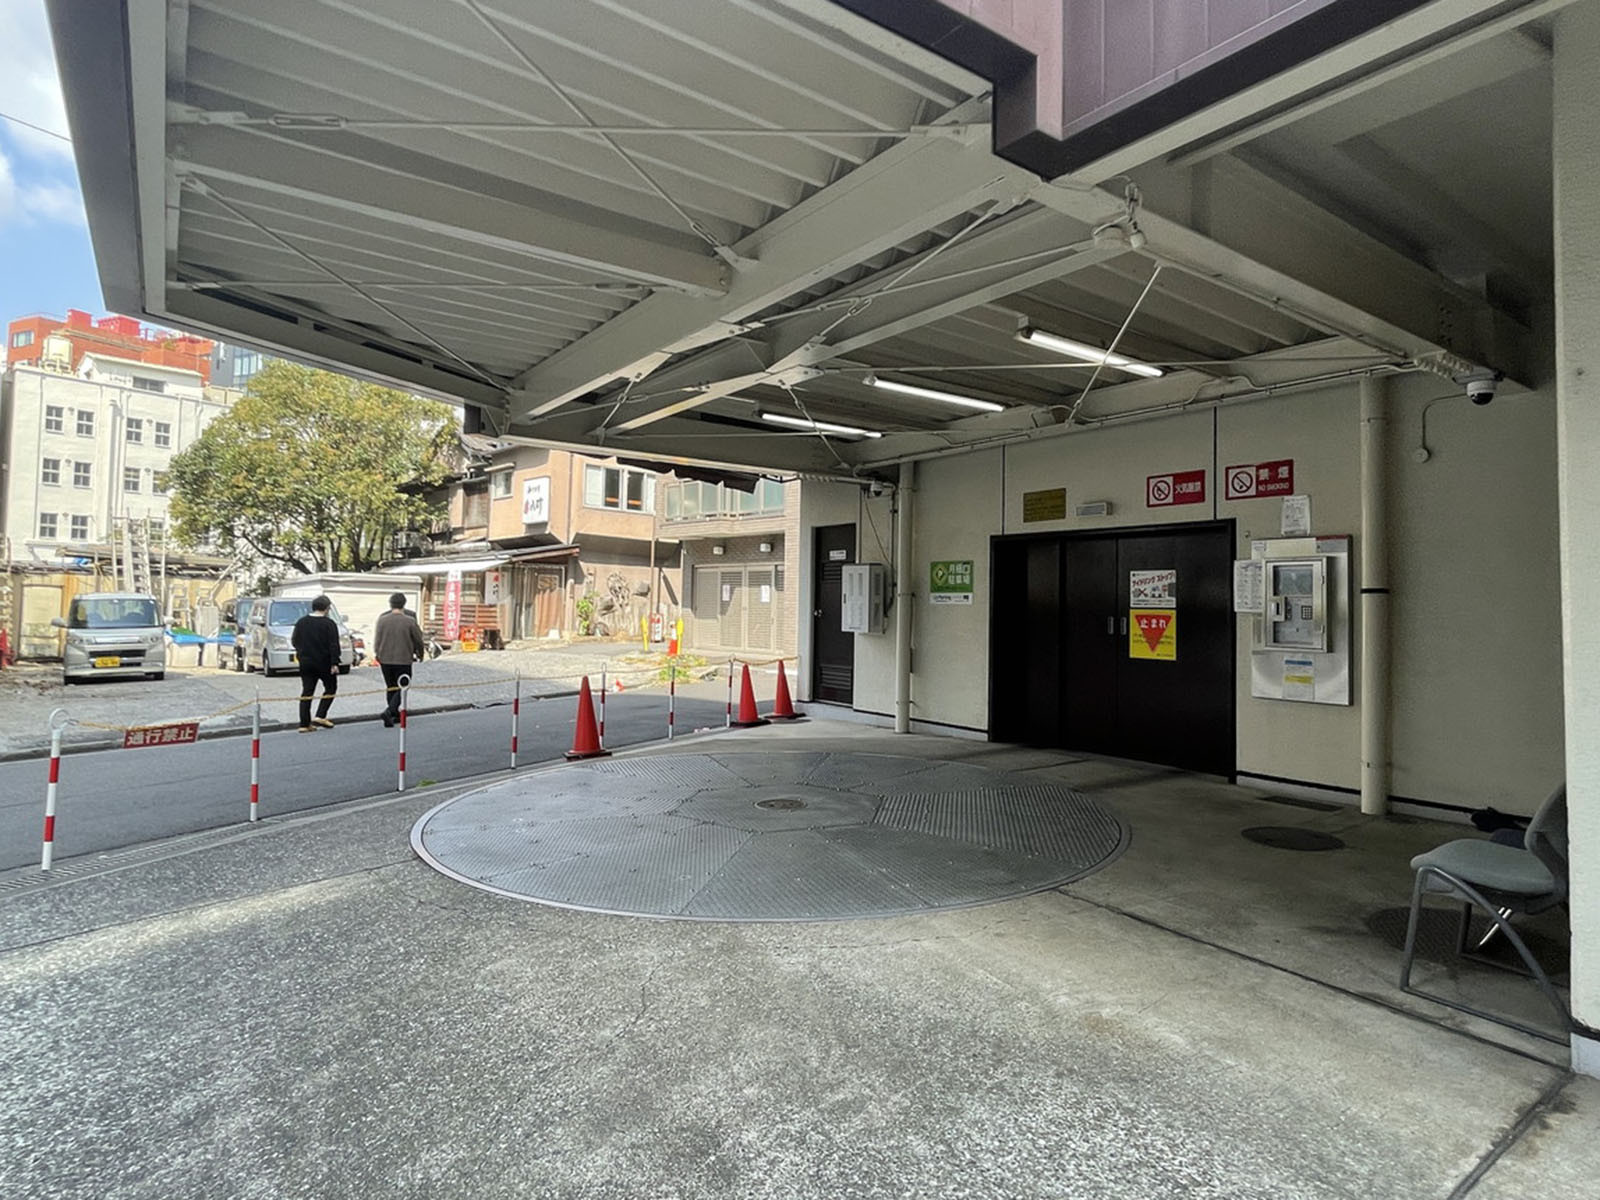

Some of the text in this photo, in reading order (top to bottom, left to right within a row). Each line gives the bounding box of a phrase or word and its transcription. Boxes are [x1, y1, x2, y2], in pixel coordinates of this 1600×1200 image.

[1140, 617, 1167, 629] 止まれ
[126, 726, 194, 746] 通行禁止
